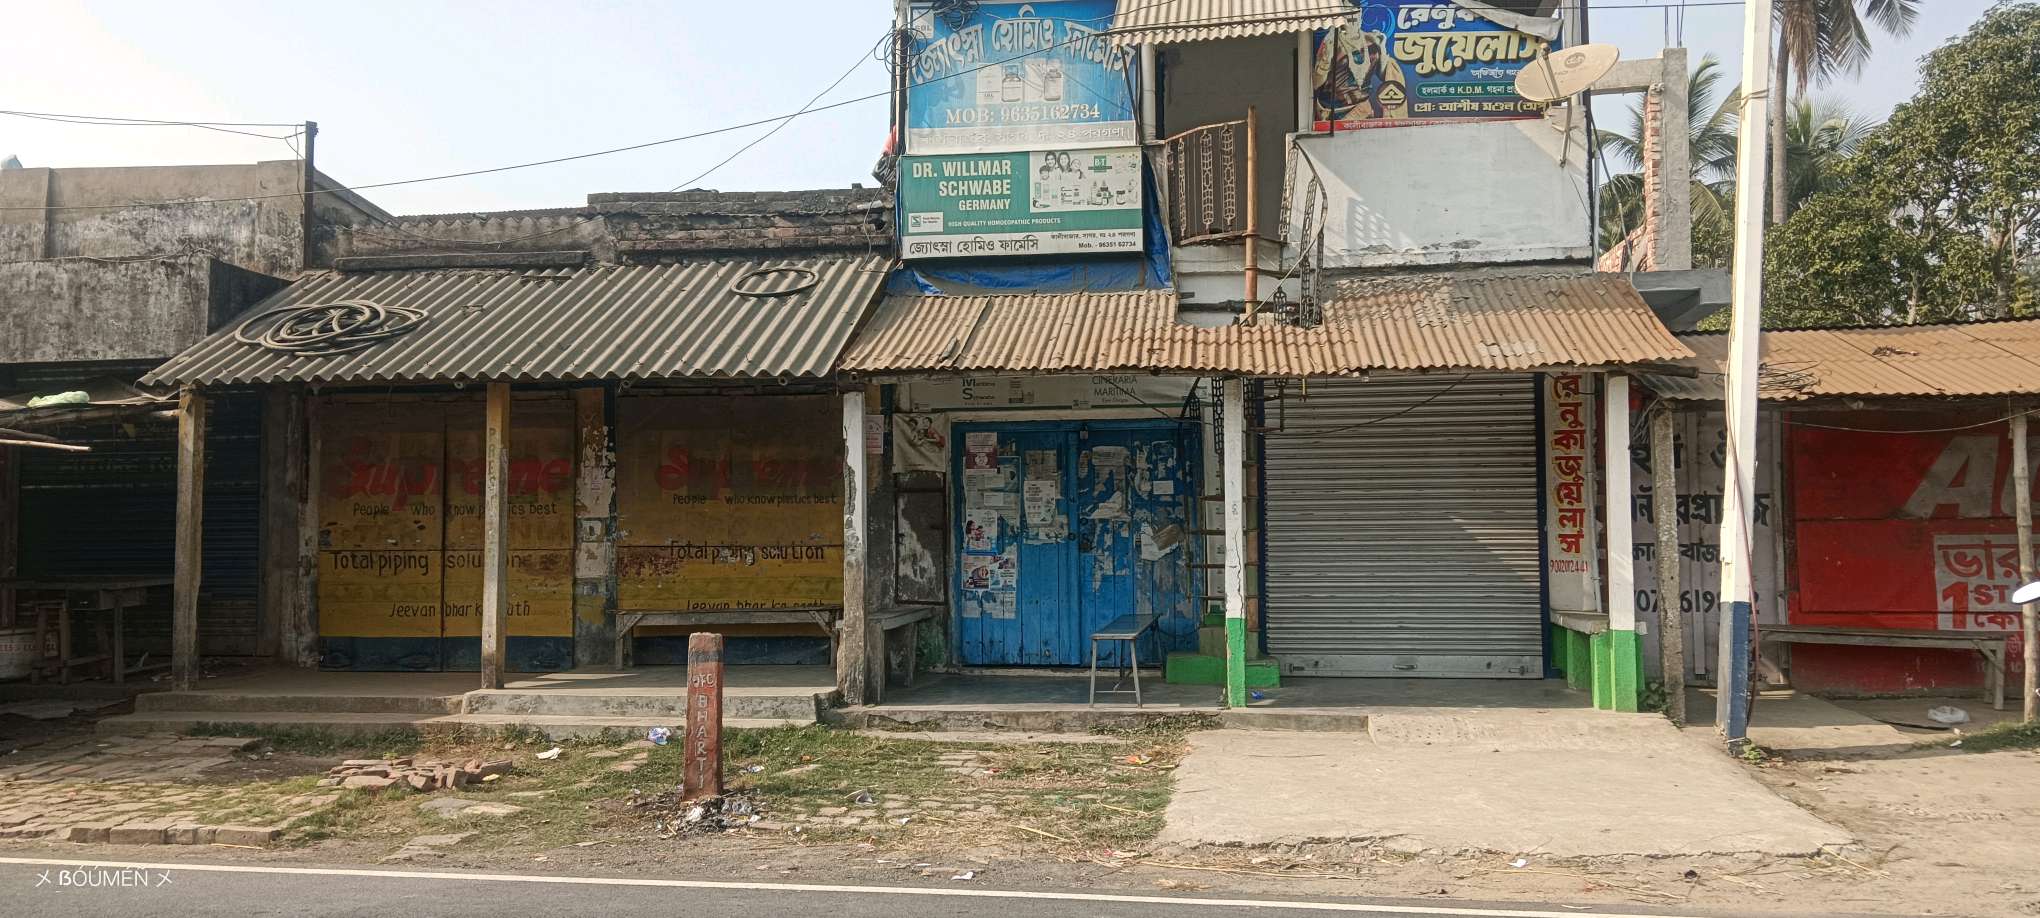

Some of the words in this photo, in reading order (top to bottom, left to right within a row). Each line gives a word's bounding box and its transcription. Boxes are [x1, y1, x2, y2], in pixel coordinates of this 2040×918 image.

[991, 5, 1055, 51] হোমিও
[1457, 85, 1484, 94] K.D.M.
[946, 108, 995, 124] MOB:
[1000, 103, 1100, 121] 9635162734
[912, 162, 938, 178] DR.
[942, 159, 1012, 177] WILLMAR
[938, 179, 1012, 197] SCHWABE
[958, 198, 1011, 211] GERMANY
[963, 219, 986, 227] QUALITY
[1031, 217, 1061, 225] PRODUCTS
[956, 235, 995, 254] হোমিও
[998, 233, 1039, 251] ফার্মেসি
[352, 502, 390, 518] People
[670, 540, 708, 560] Total
[761, 541, 824, 560] solution
[331, 550, 374, 570] Total
[378, 552, 429, 576] piping
[389, 601, 436, 618] Jeevan
